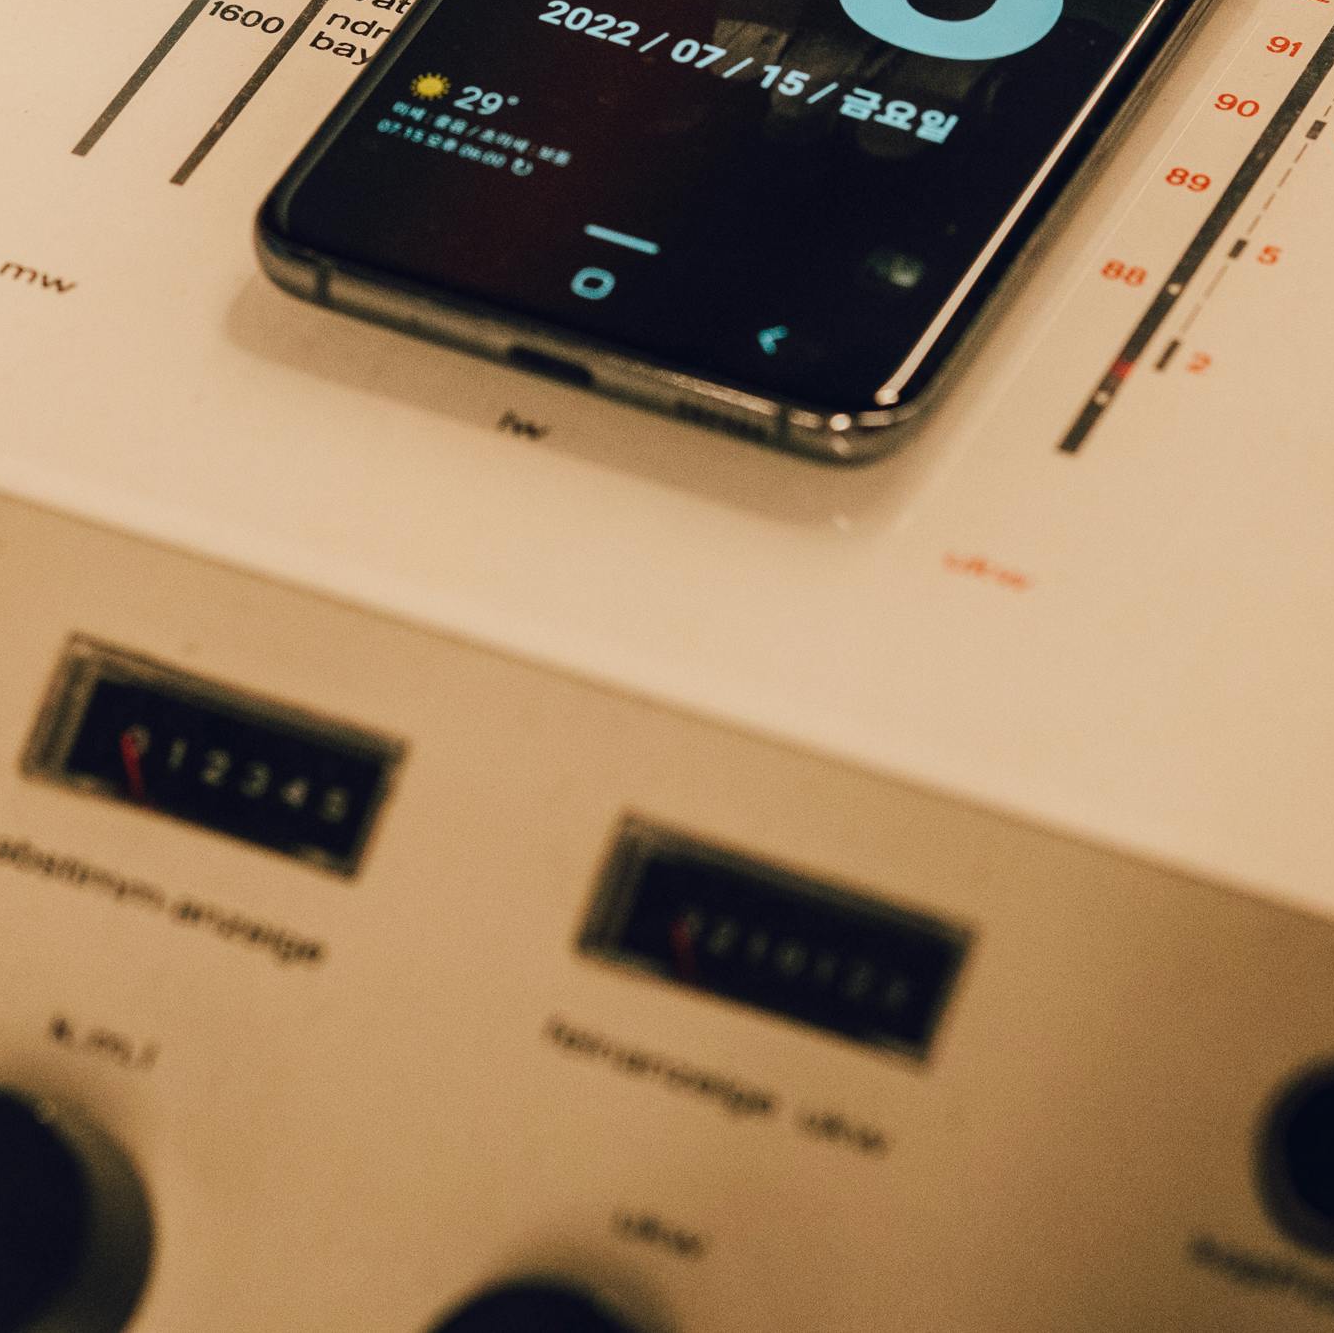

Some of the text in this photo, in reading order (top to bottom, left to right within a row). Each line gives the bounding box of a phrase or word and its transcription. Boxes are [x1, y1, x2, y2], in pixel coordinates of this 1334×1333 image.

[208, 0, 285, 35] 1600
[325, 11, 391, 42] ndr
[310, 31, 373, 68] bay
[1266, 36, 1303, 58] 91
[538, 0, 641, 47] 2022
[670, 38, 727, 69] 07
[760, 64, 810, 96] 15
[839, 87, 959, 144] 금요일
[1214, 93, 1260, 118] 90
[1164, 168, 1212, 193] 89
[1256, 245, 1283, 266] 5
[1101, 259, 1147, 288] 88
